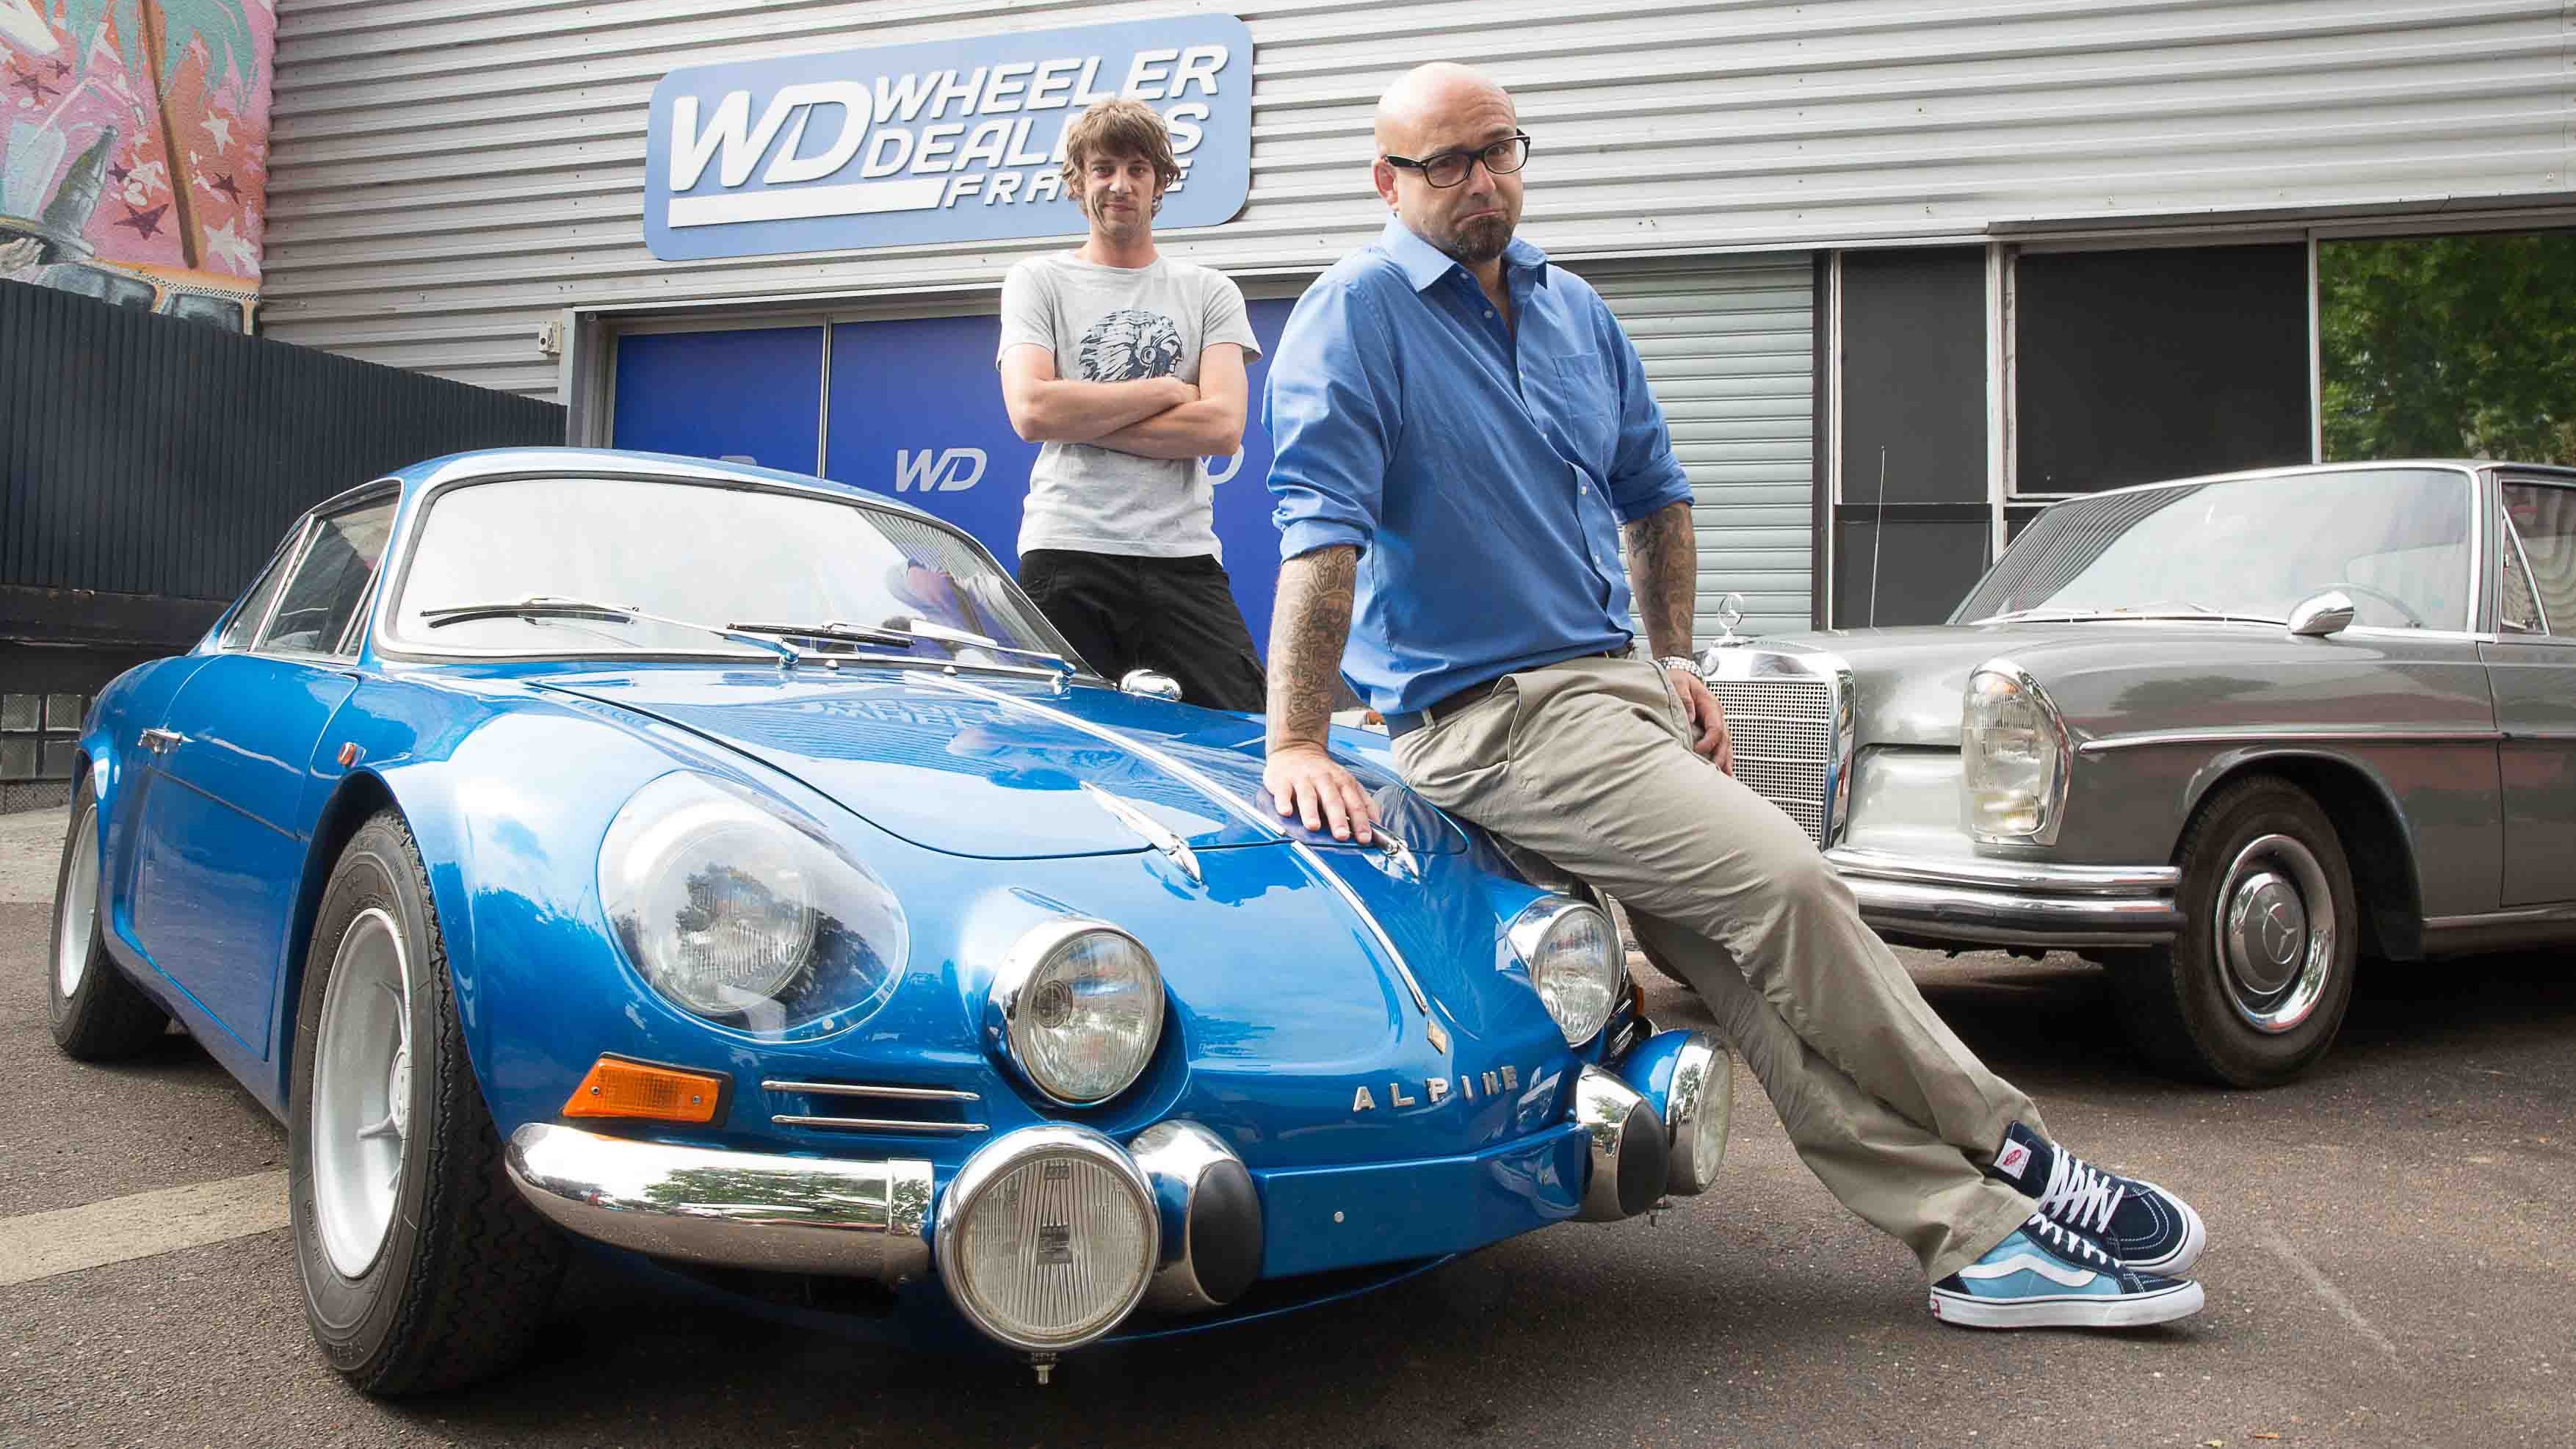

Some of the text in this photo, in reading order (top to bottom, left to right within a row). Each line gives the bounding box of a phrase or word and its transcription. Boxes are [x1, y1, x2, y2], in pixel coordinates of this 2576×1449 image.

[874, 44, 1229, 123] WHEELER
[670, 81, 874, 191] WD
[861, 102, 1211, 178] DEALS
[896, 447, 988, 491] WD
[1353, 1065, 1519, 1112] ALPINE
